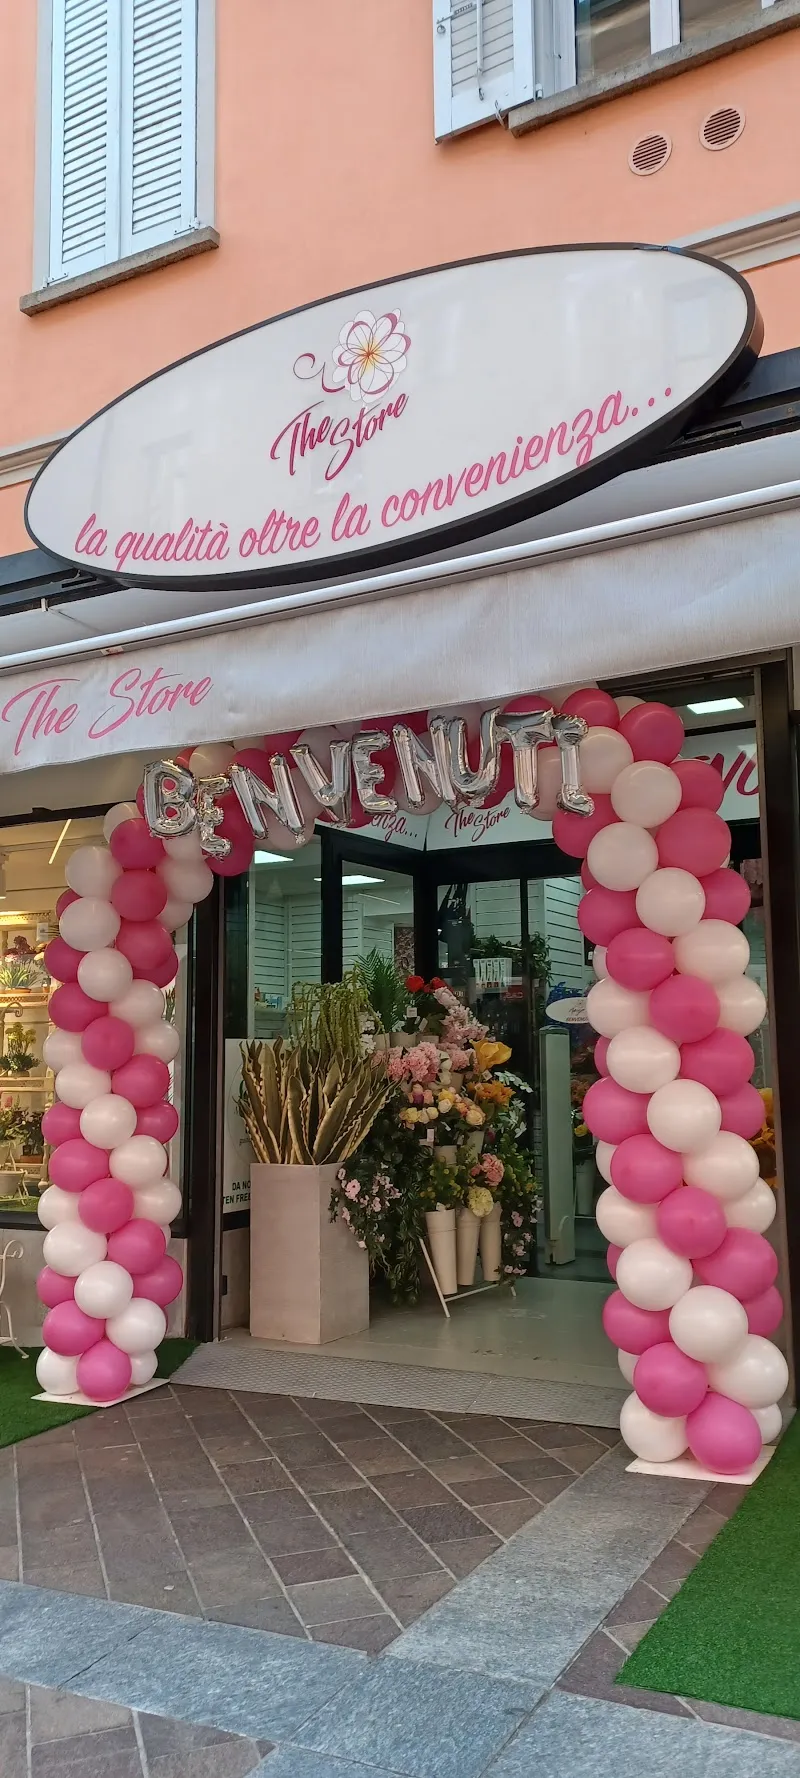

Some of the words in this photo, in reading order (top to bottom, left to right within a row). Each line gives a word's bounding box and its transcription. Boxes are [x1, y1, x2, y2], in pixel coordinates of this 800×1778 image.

[74, 513, 108, 557] la
[114, 516, 231, 572] qualità
[239, 508, 322, 558] oltre
[331, 492, 371, 542] la
[381, 387, 673, 528] convenienza...
[270, 400, 334, 476] The
[325, 393, 409, 481] Store
[1, 678, 81, 756] The
[88, 667, 214, 739] Store
[143, 706, 595, 858] BENVENUTI
[444, 806, 475, 838] The
[472, 807, 511, 842] Store
[232, 1181, 241, 1191] DA
